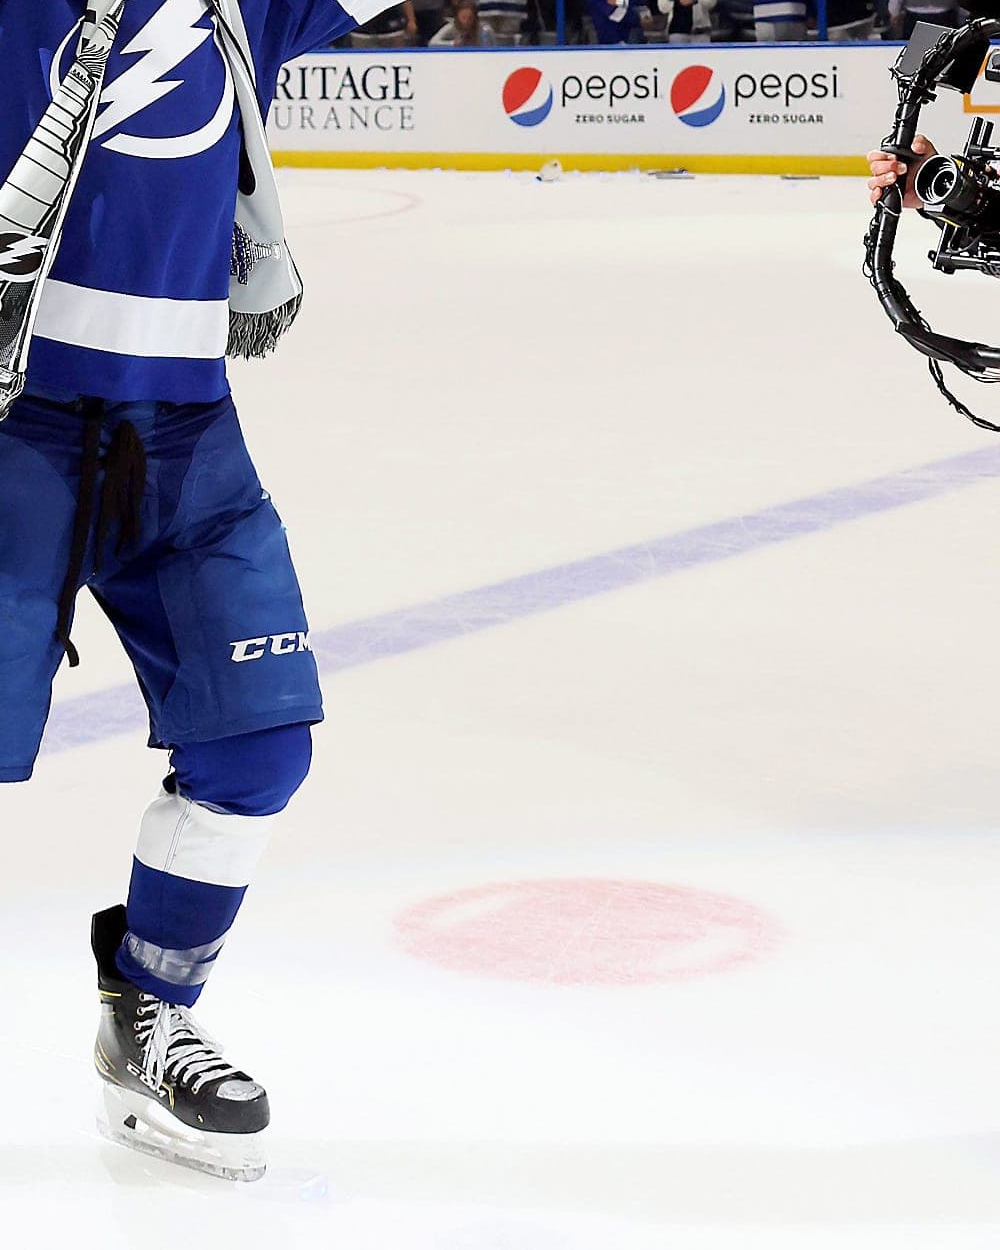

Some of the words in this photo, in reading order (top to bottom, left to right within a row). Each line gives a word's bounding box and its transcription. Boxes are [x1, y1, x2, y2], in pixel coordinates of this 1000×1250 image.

[561, 67, 660, 108] pepsi
[735, 65, 839, 108] pepsi
[274, 105, 415, 130] URANCE
[575, 113, 605, 124] ZERO
[607, 113, 646, 124] SUGAR
[749, 113, 780, 124] ZERO
[783, 113, 824, 124] SUGAR
